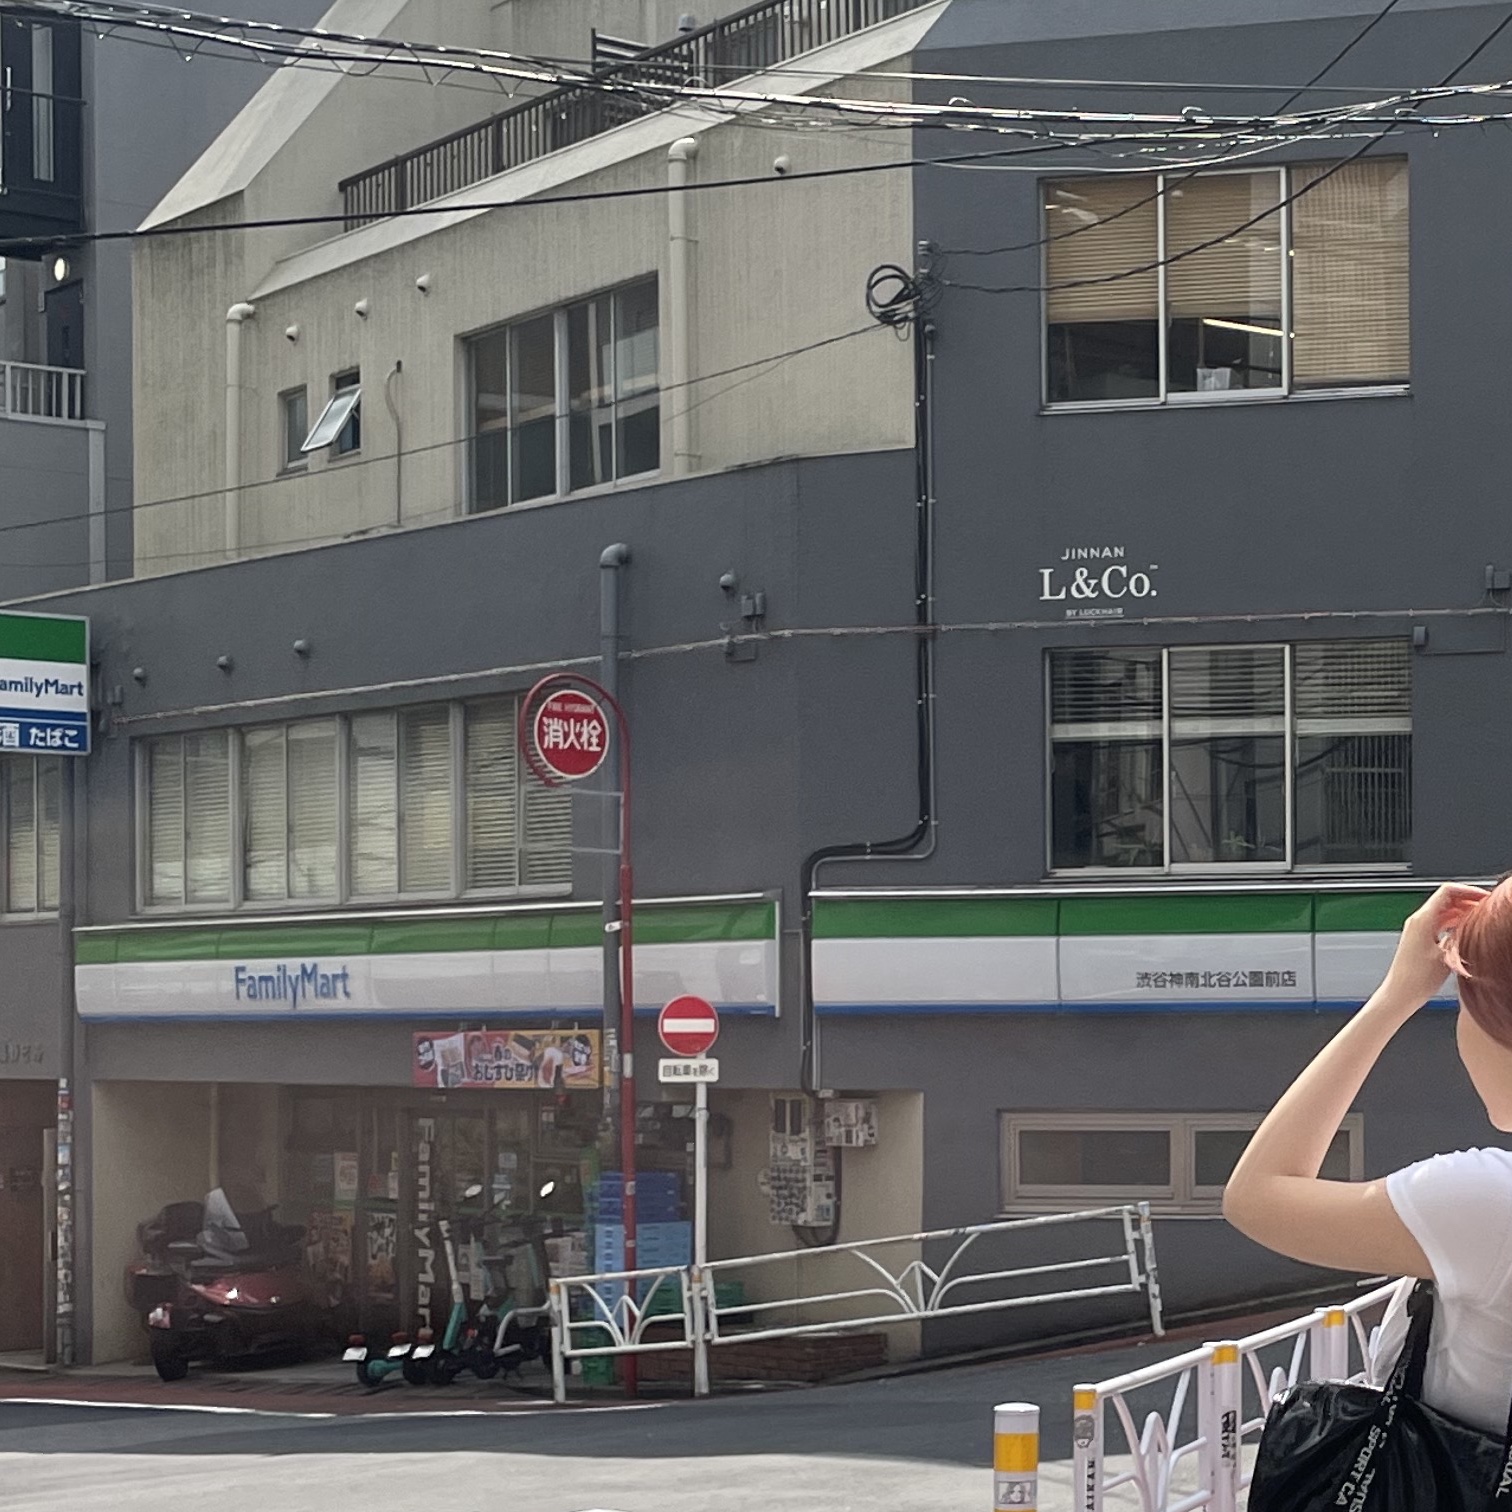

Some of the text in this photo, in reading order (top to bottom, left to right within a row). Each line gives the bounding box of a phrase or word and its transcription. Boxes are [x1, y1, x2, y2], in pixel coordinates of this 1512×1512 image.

[1061, 546, 1125, 560] JINNAN
[1039, 565, 1157, 600] L&Co.
[0, 677, 84, 698] amilyMart
[29, 727, 80, 749] たばこ
[542, 716, 602, 752] 消火栓
[234, 962, 351, 1010] FamilyMart
[1136, 970, 1297, 989] 渋谷神南北谷公園前店
[414, 1117, 435, 1331] FamilyMar
[1350, 1424, 1381, 1483] SPORT
